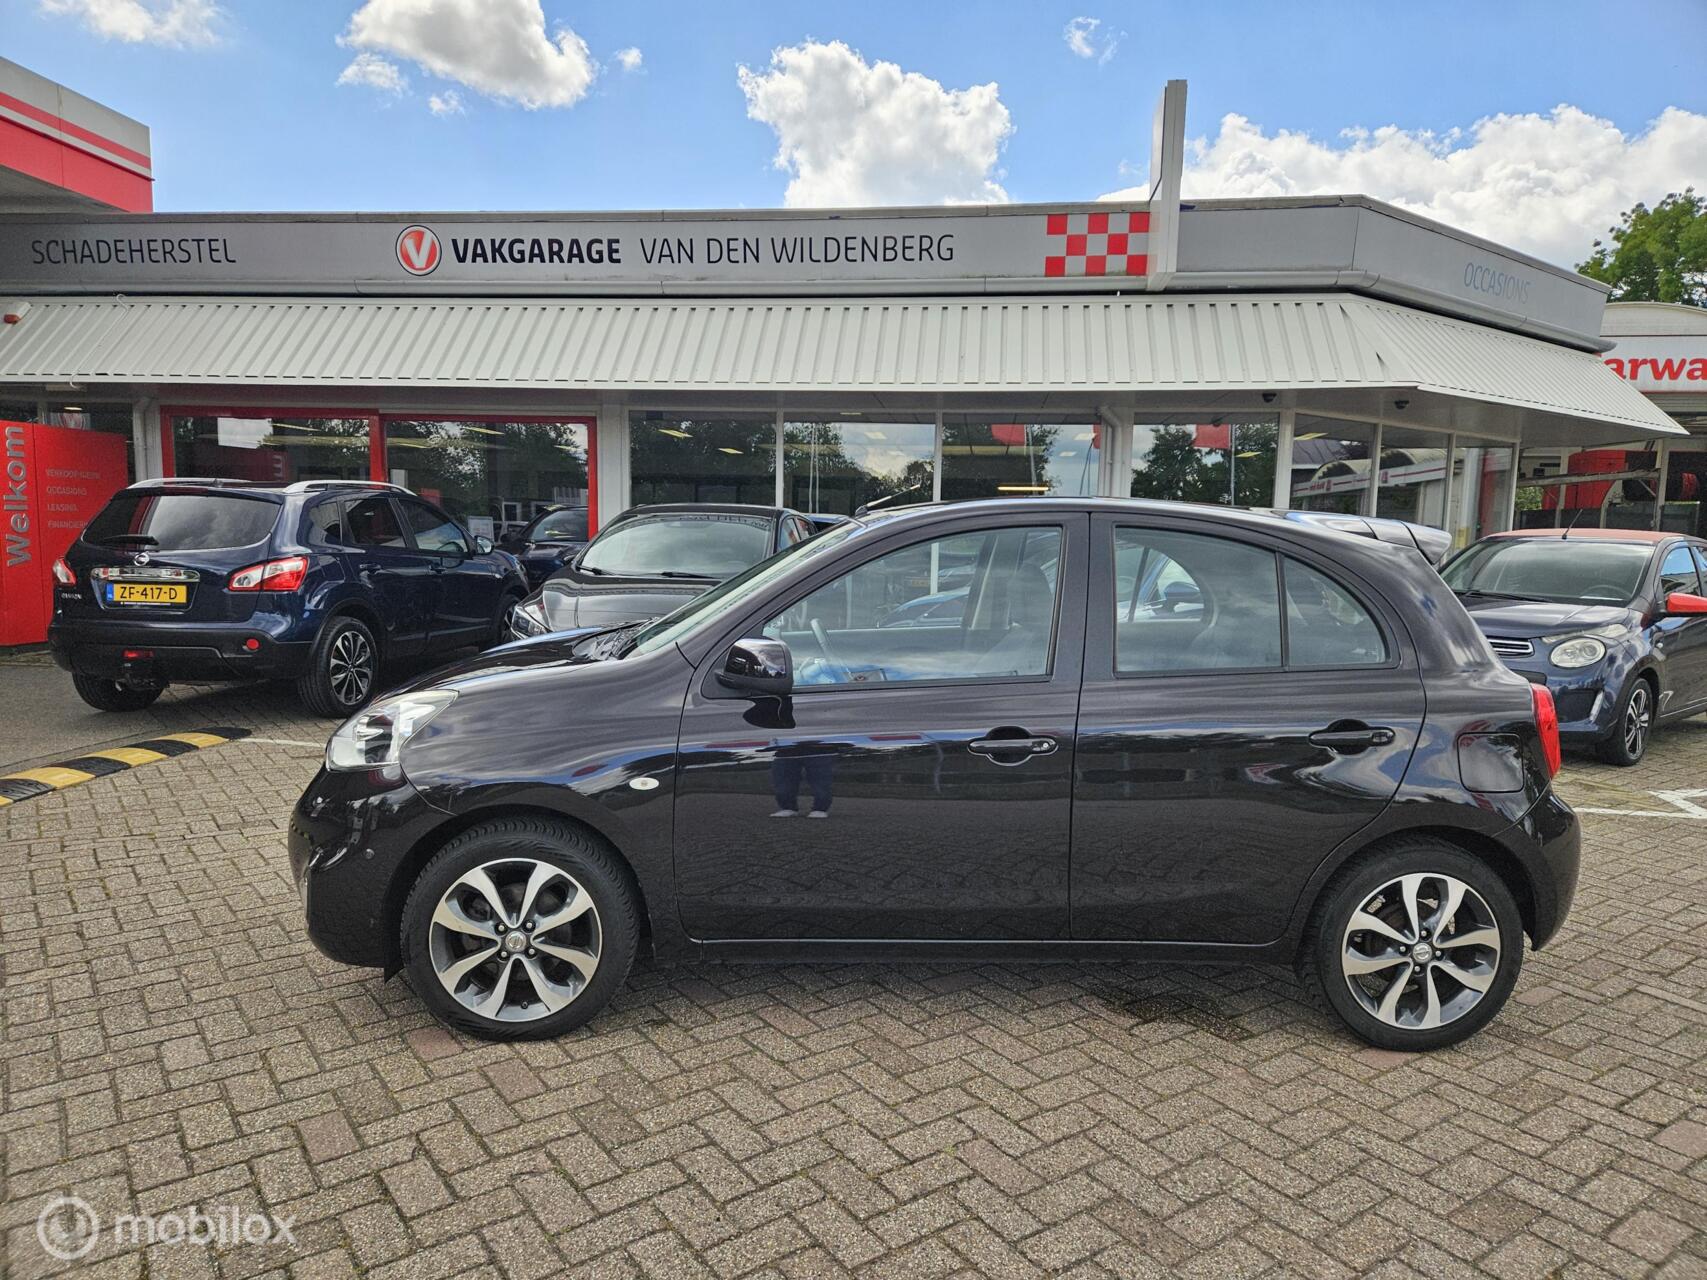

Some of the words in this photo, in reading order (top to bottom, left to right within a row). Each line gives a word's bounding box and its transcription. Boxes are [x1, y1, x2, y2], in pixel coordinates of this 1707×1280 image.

[31, 238, 237, 265] SCHADEHERSTEL
[403, 230, 436, 270] V
[451, 238, 622, 264] VAKGARAGE
[639, 237, 695, 264] VAN
[706, 237, 760, 264] DEN
[770, 234, 955, 263] WILDENBERG
[1463, 262, 1531, 304] OCCASIONS
[1602, 357, 1707, 381] arwa
[3, 426, 32, 567] Welkom
[46, 486, 88, 496] OCCASIONS
[120, 586, 178, 600] ZF-417-D
